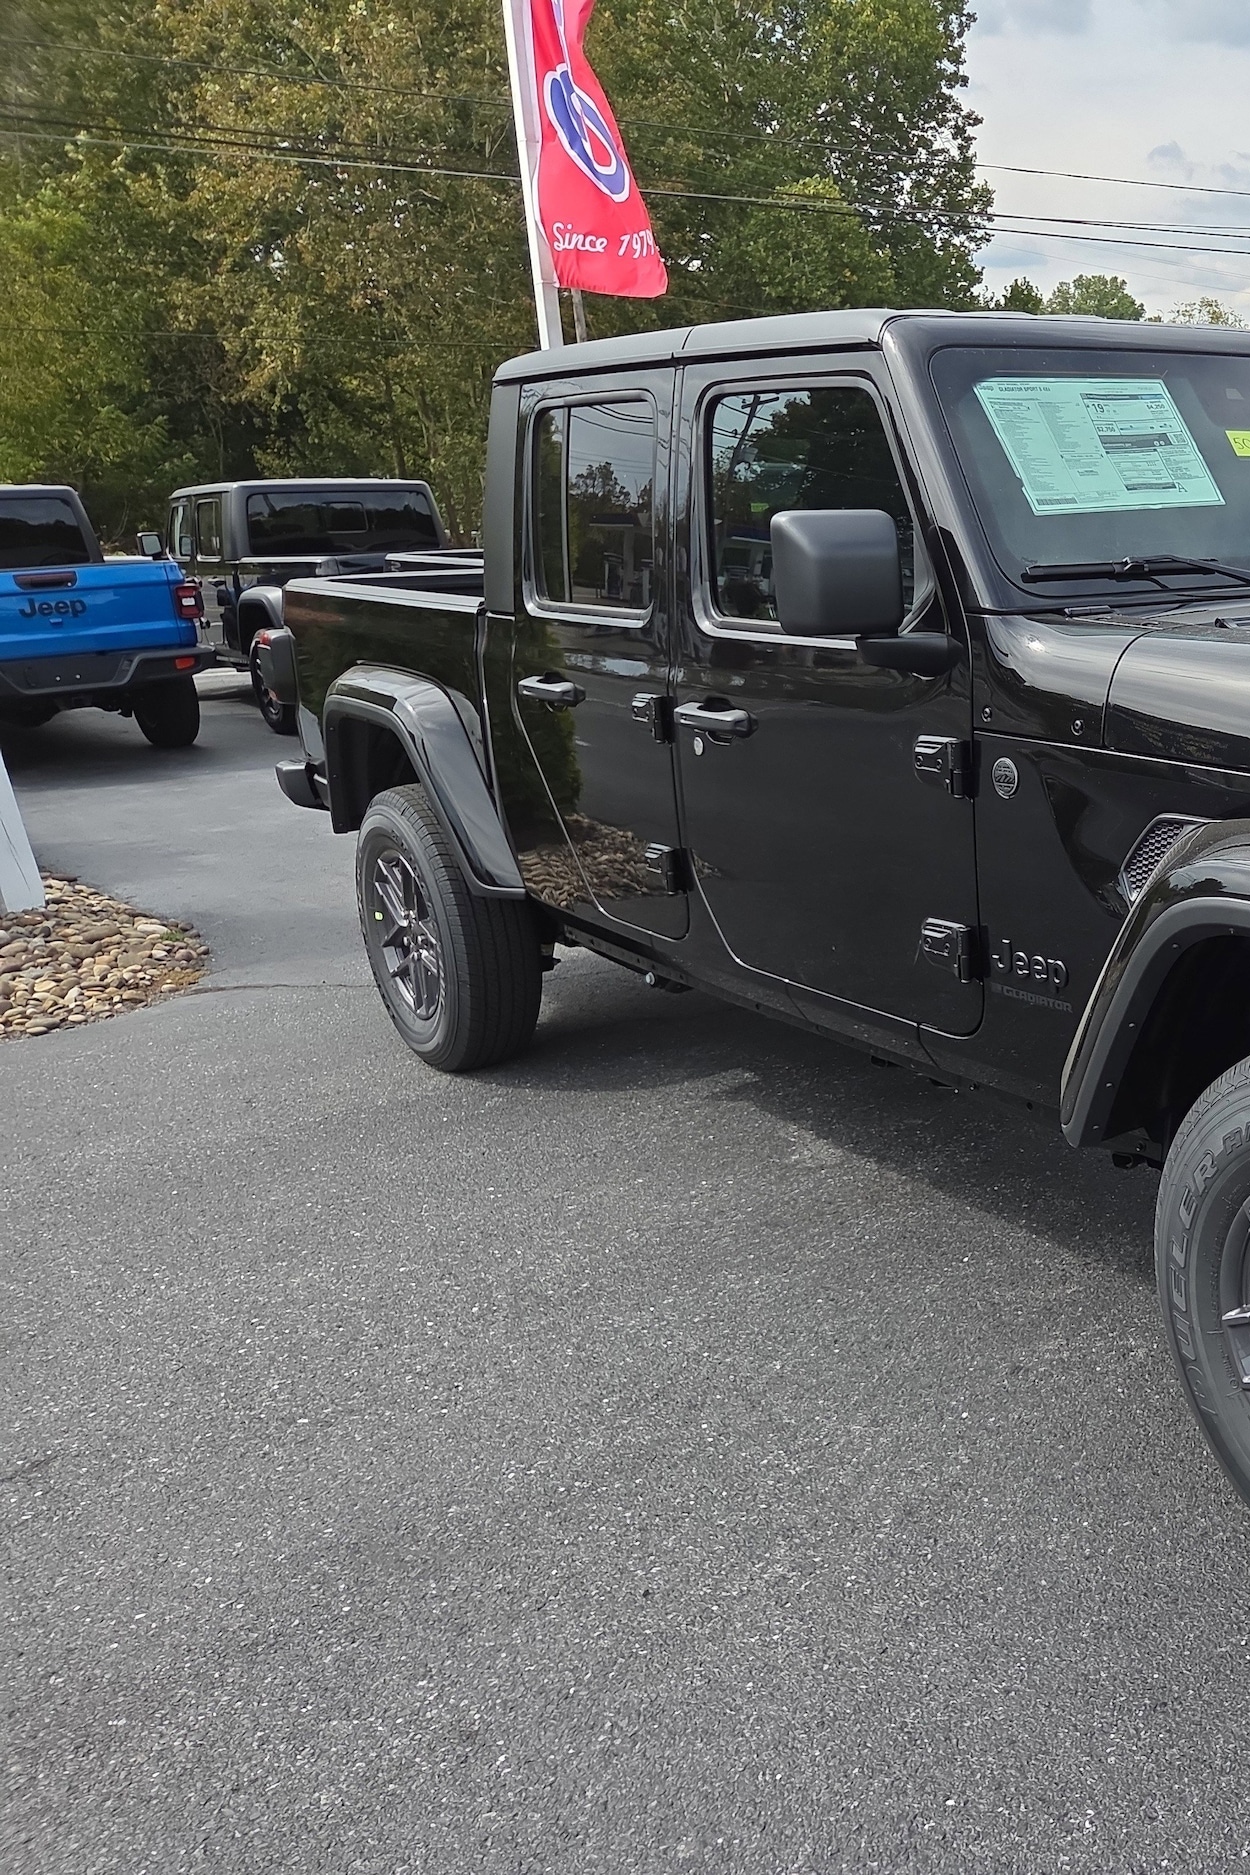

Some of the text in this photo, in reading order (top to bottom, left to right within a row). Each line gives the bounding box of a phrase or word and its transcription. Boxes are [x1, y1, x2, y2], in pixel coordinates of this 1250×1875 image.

[552, 222, 607, 253] Since
[1091, 403, 1105, 413] 19
[19, 598, 87, 619] Jeep
[991, 938, 1070, 994] Jeep
[1002, 985, 1074, 1014] GLADIATOR
